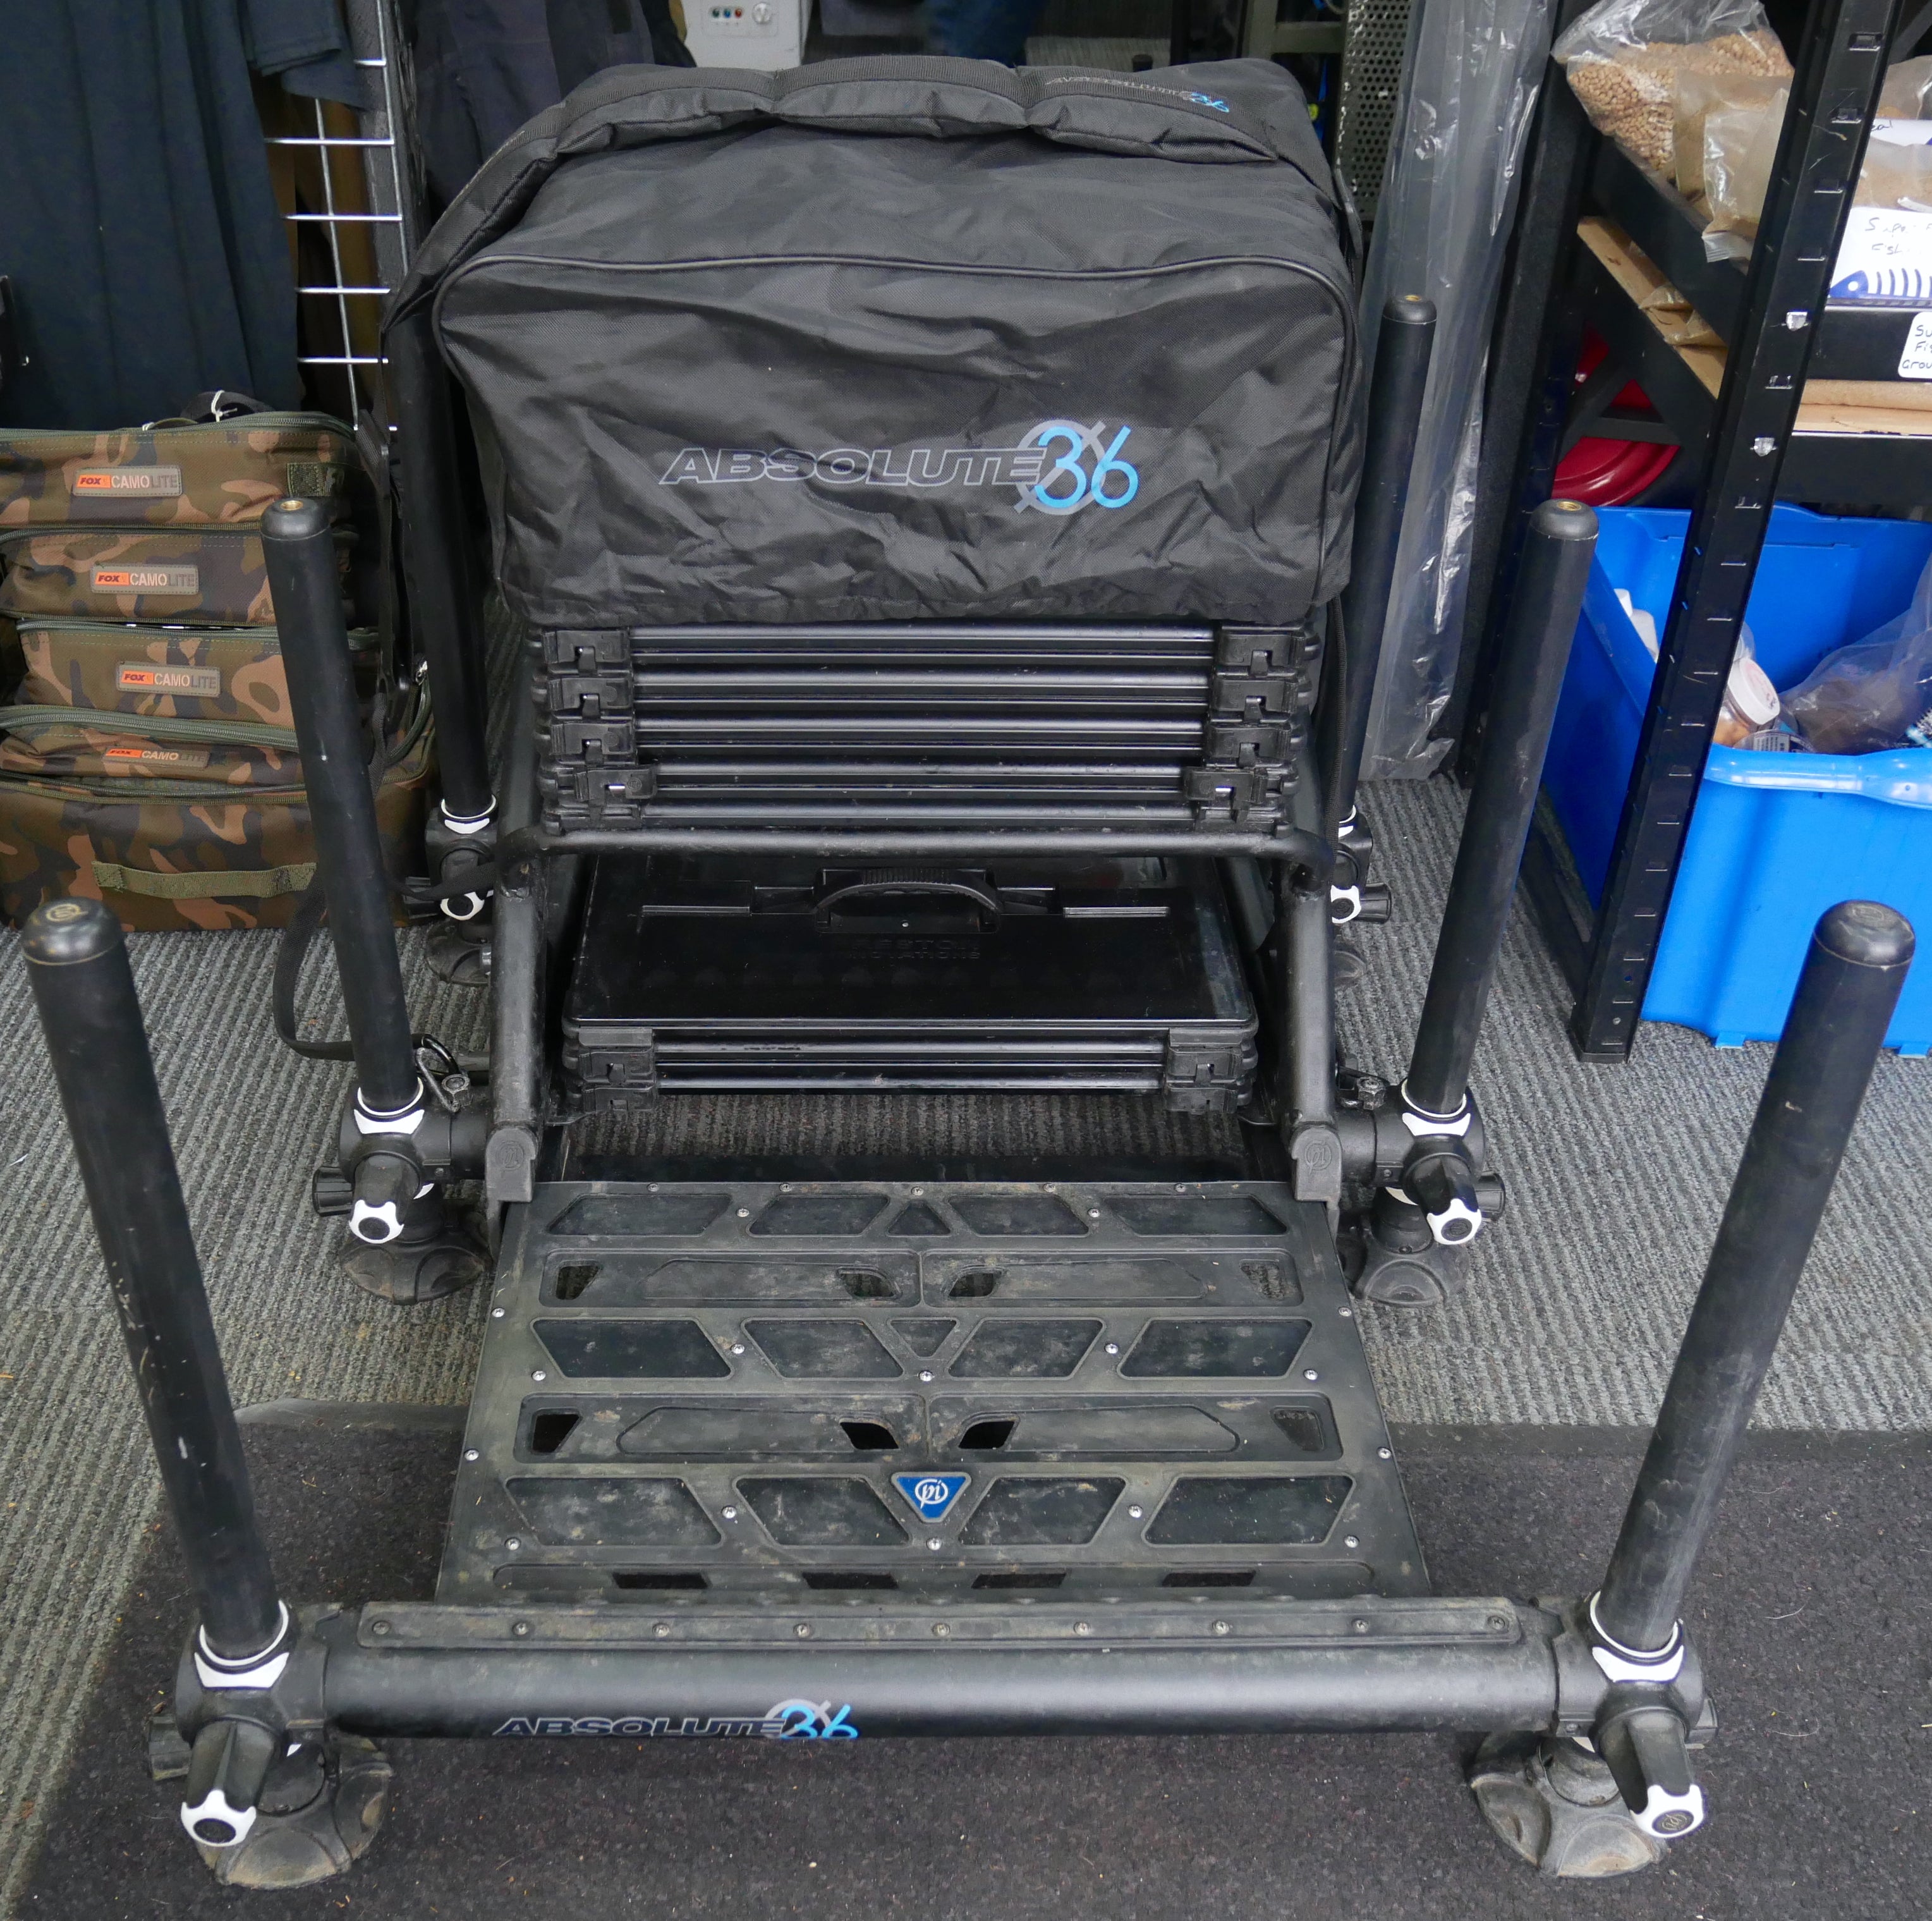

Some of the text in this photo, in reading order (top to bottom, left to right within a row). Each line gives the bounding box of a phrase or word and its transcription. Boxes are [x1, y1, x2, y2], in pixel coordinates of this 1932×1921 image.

[1914, 324, 1932, 337] Su
[1902, 359, 1932, 369] Grou
[659, 424, 1140, 510] ABSOLUTE 36
[80, 477, 101, 485] FOX
[98, 575, 120, 583] FOX
[125, 673, 145, 681] FOX
[492, 1702, 860, 1739] ABSOLUTE 36
